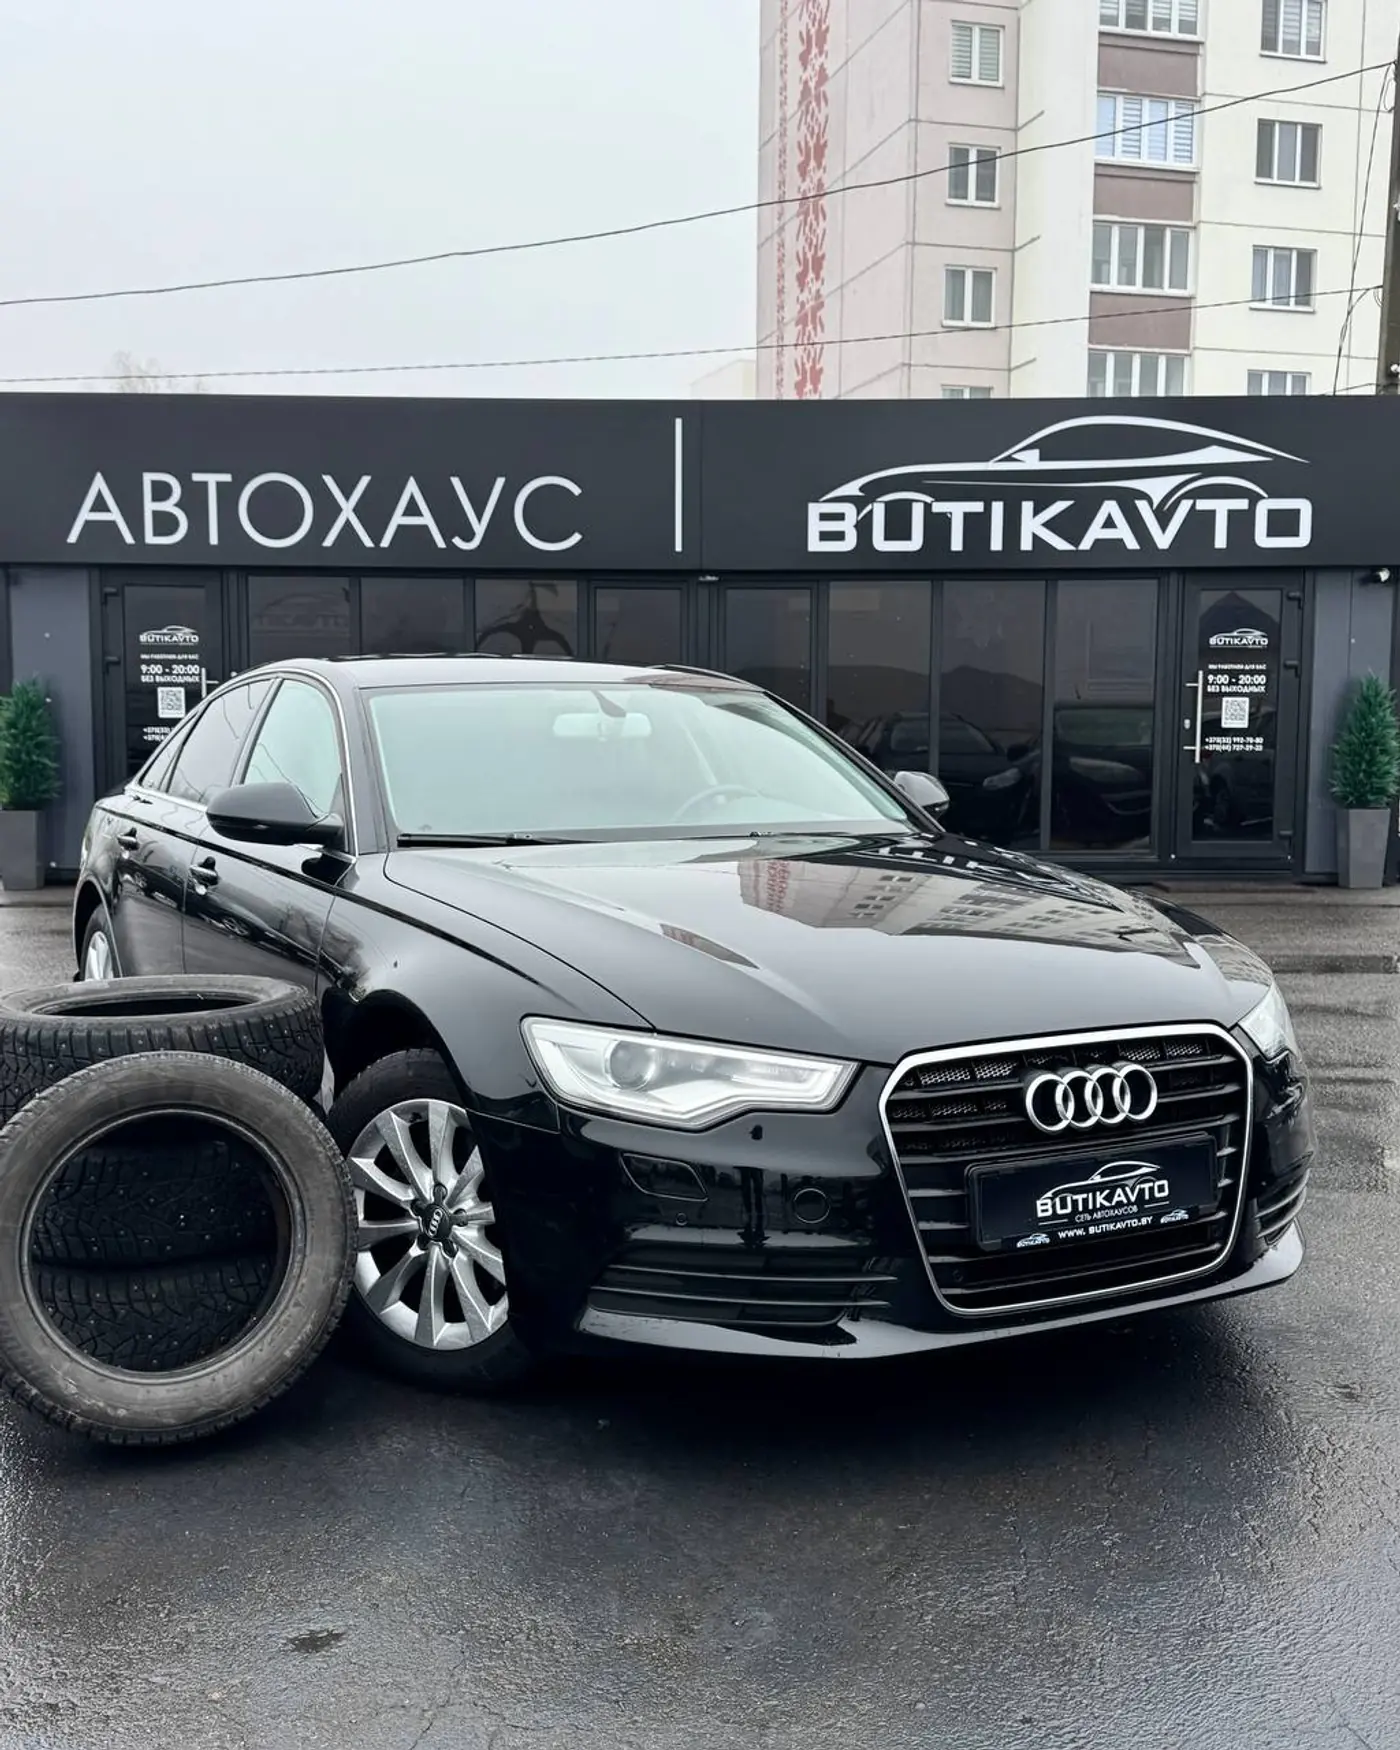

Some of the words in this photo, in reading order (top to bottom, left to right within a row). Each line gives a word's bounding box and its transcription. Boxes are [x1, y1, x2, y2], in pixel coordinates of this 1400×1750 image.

[66, 471, 583, 552] АВТОХАУС
[806, 497, 1312, 553] BUTIKAVTO
[140, 634, 199, 642] BUTIKAVTO
[1209, 637, 1268, 646] BUTIKAVTO
[140, 664, 163, 674] 9:00
[171, 664, 199, 674] 20:00
[1207, 674, 1229, 684] 9:00
[1238, 674, 1266, 684] 20:00
[1036, 1179, 1169, 1218] BUTIKAVTO
[1074, 1212, 1092, 1223] СЕТЬ
[1092, 1204, 1139, 1220] АВТОХАУСОВ
